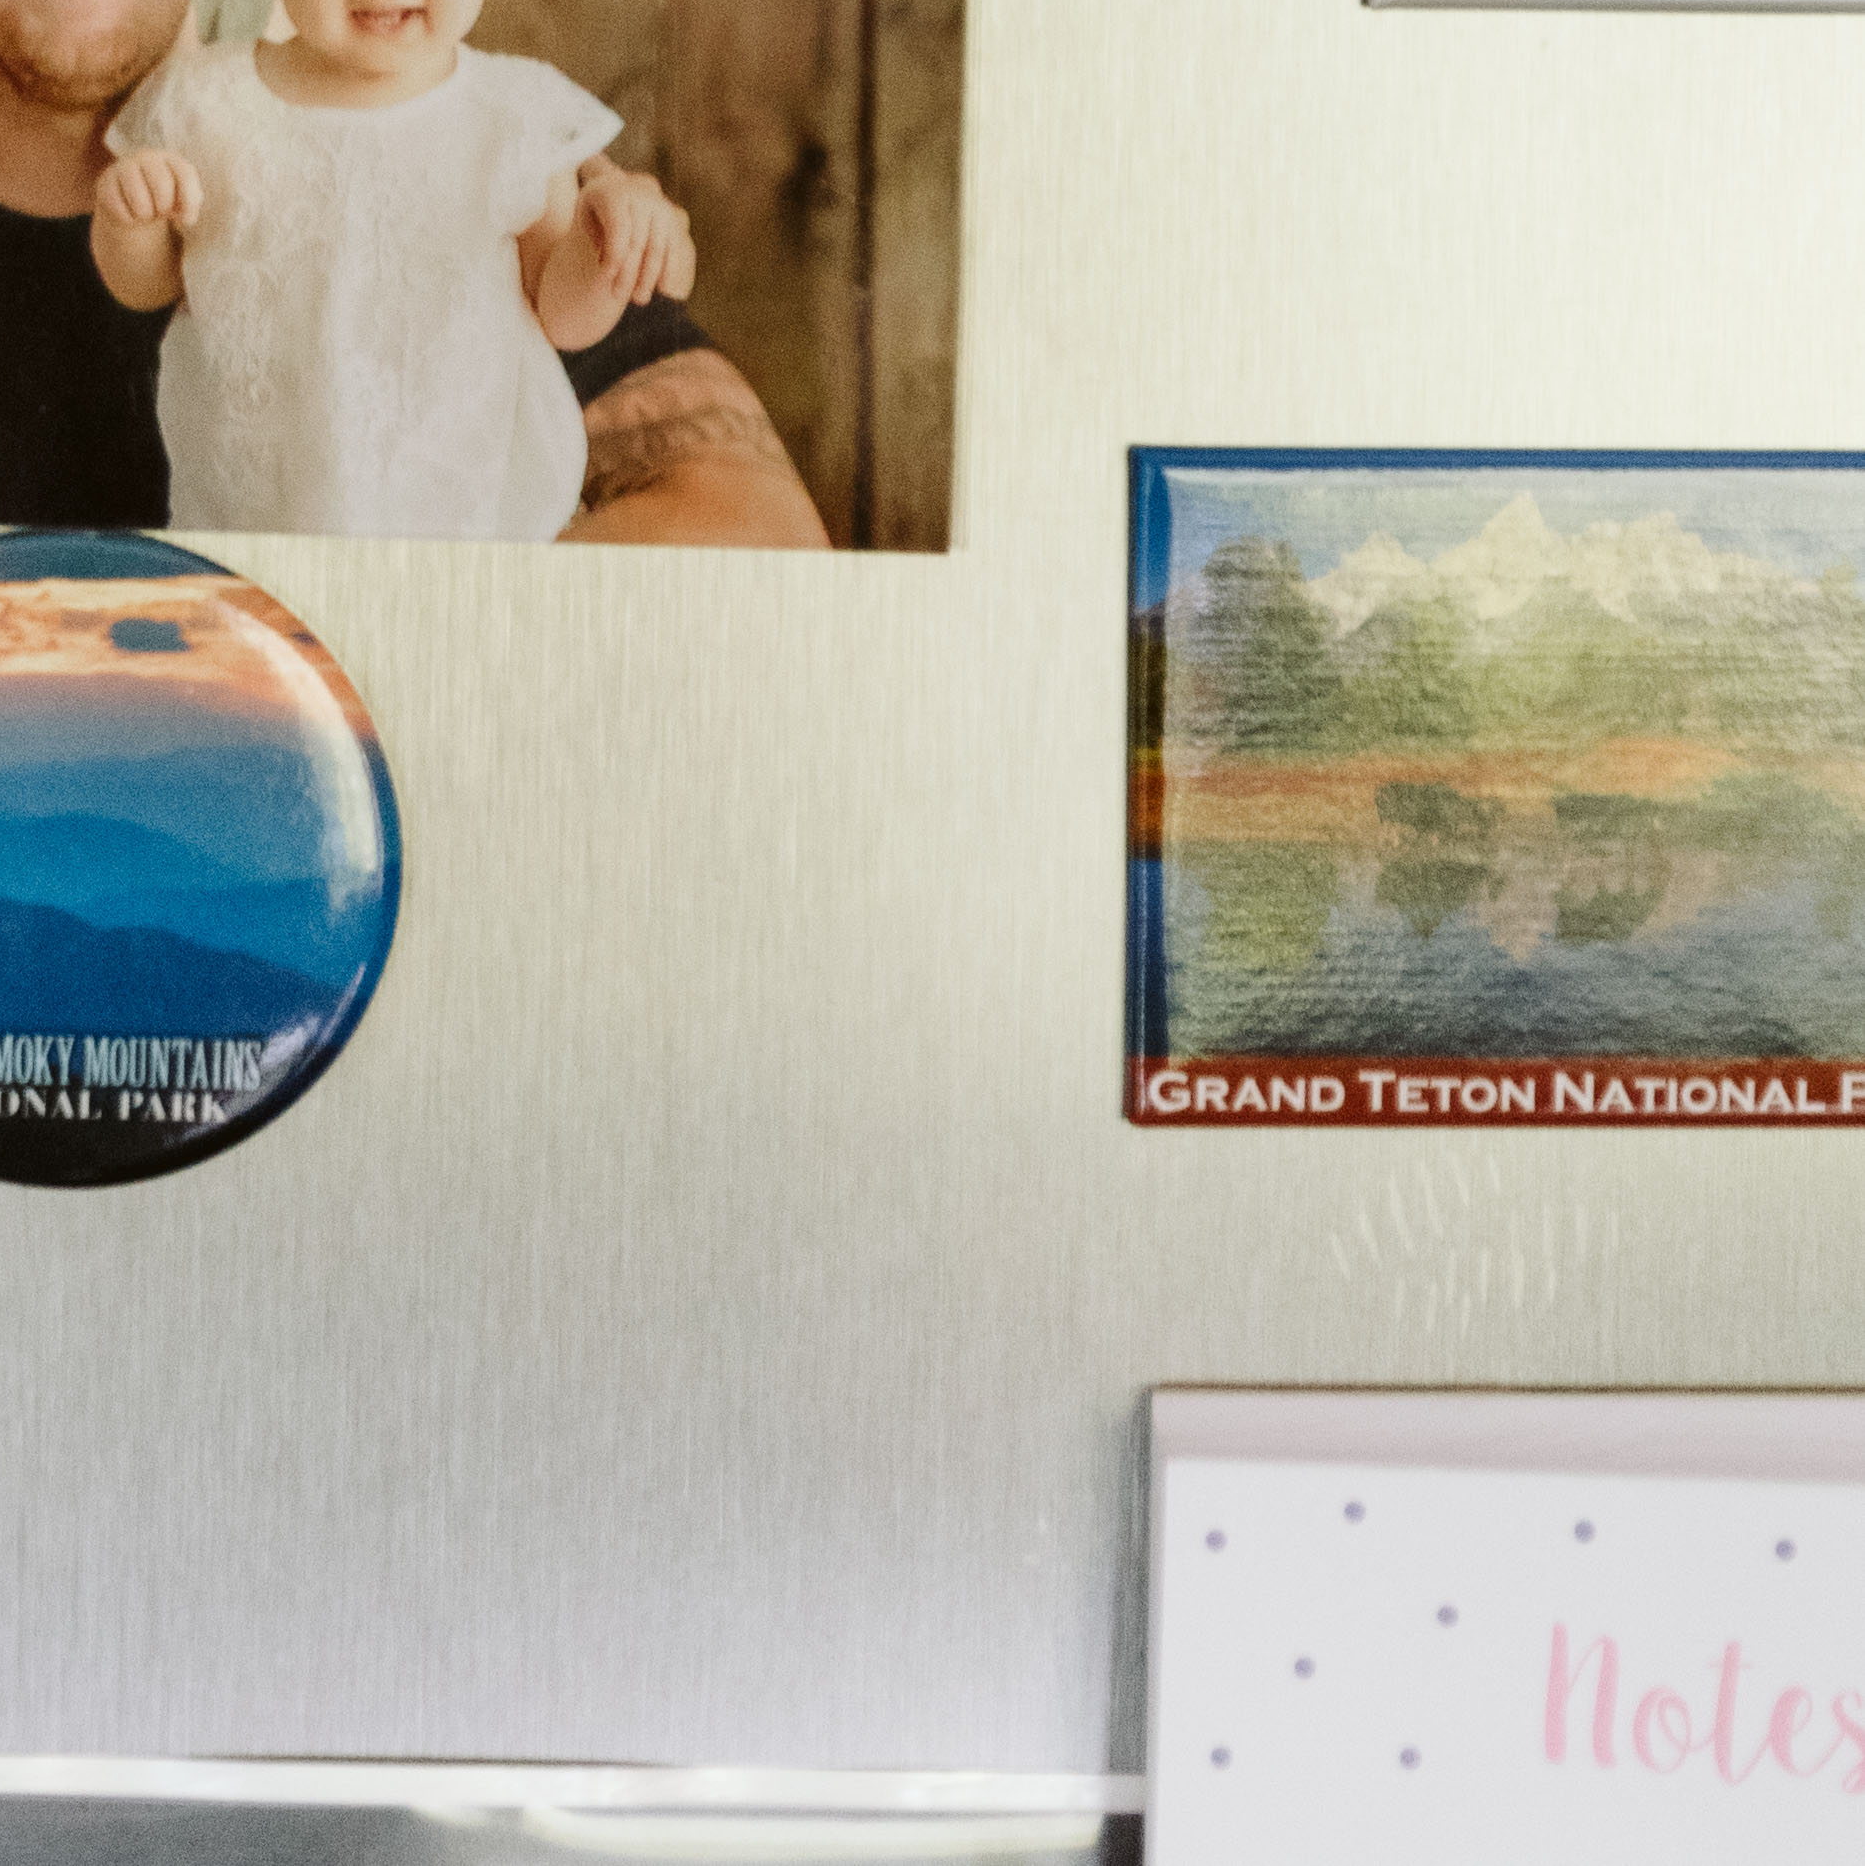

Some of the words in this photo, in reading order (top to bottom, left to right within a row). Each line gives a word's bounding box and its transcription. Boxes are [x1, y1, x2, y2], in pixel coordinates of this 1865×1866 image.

[82, 1035, 263, 1093] MOUNTAINS
[119, 1089, 228, 1125] PARK
[1543, 1622, 1865, 1795] Notes
